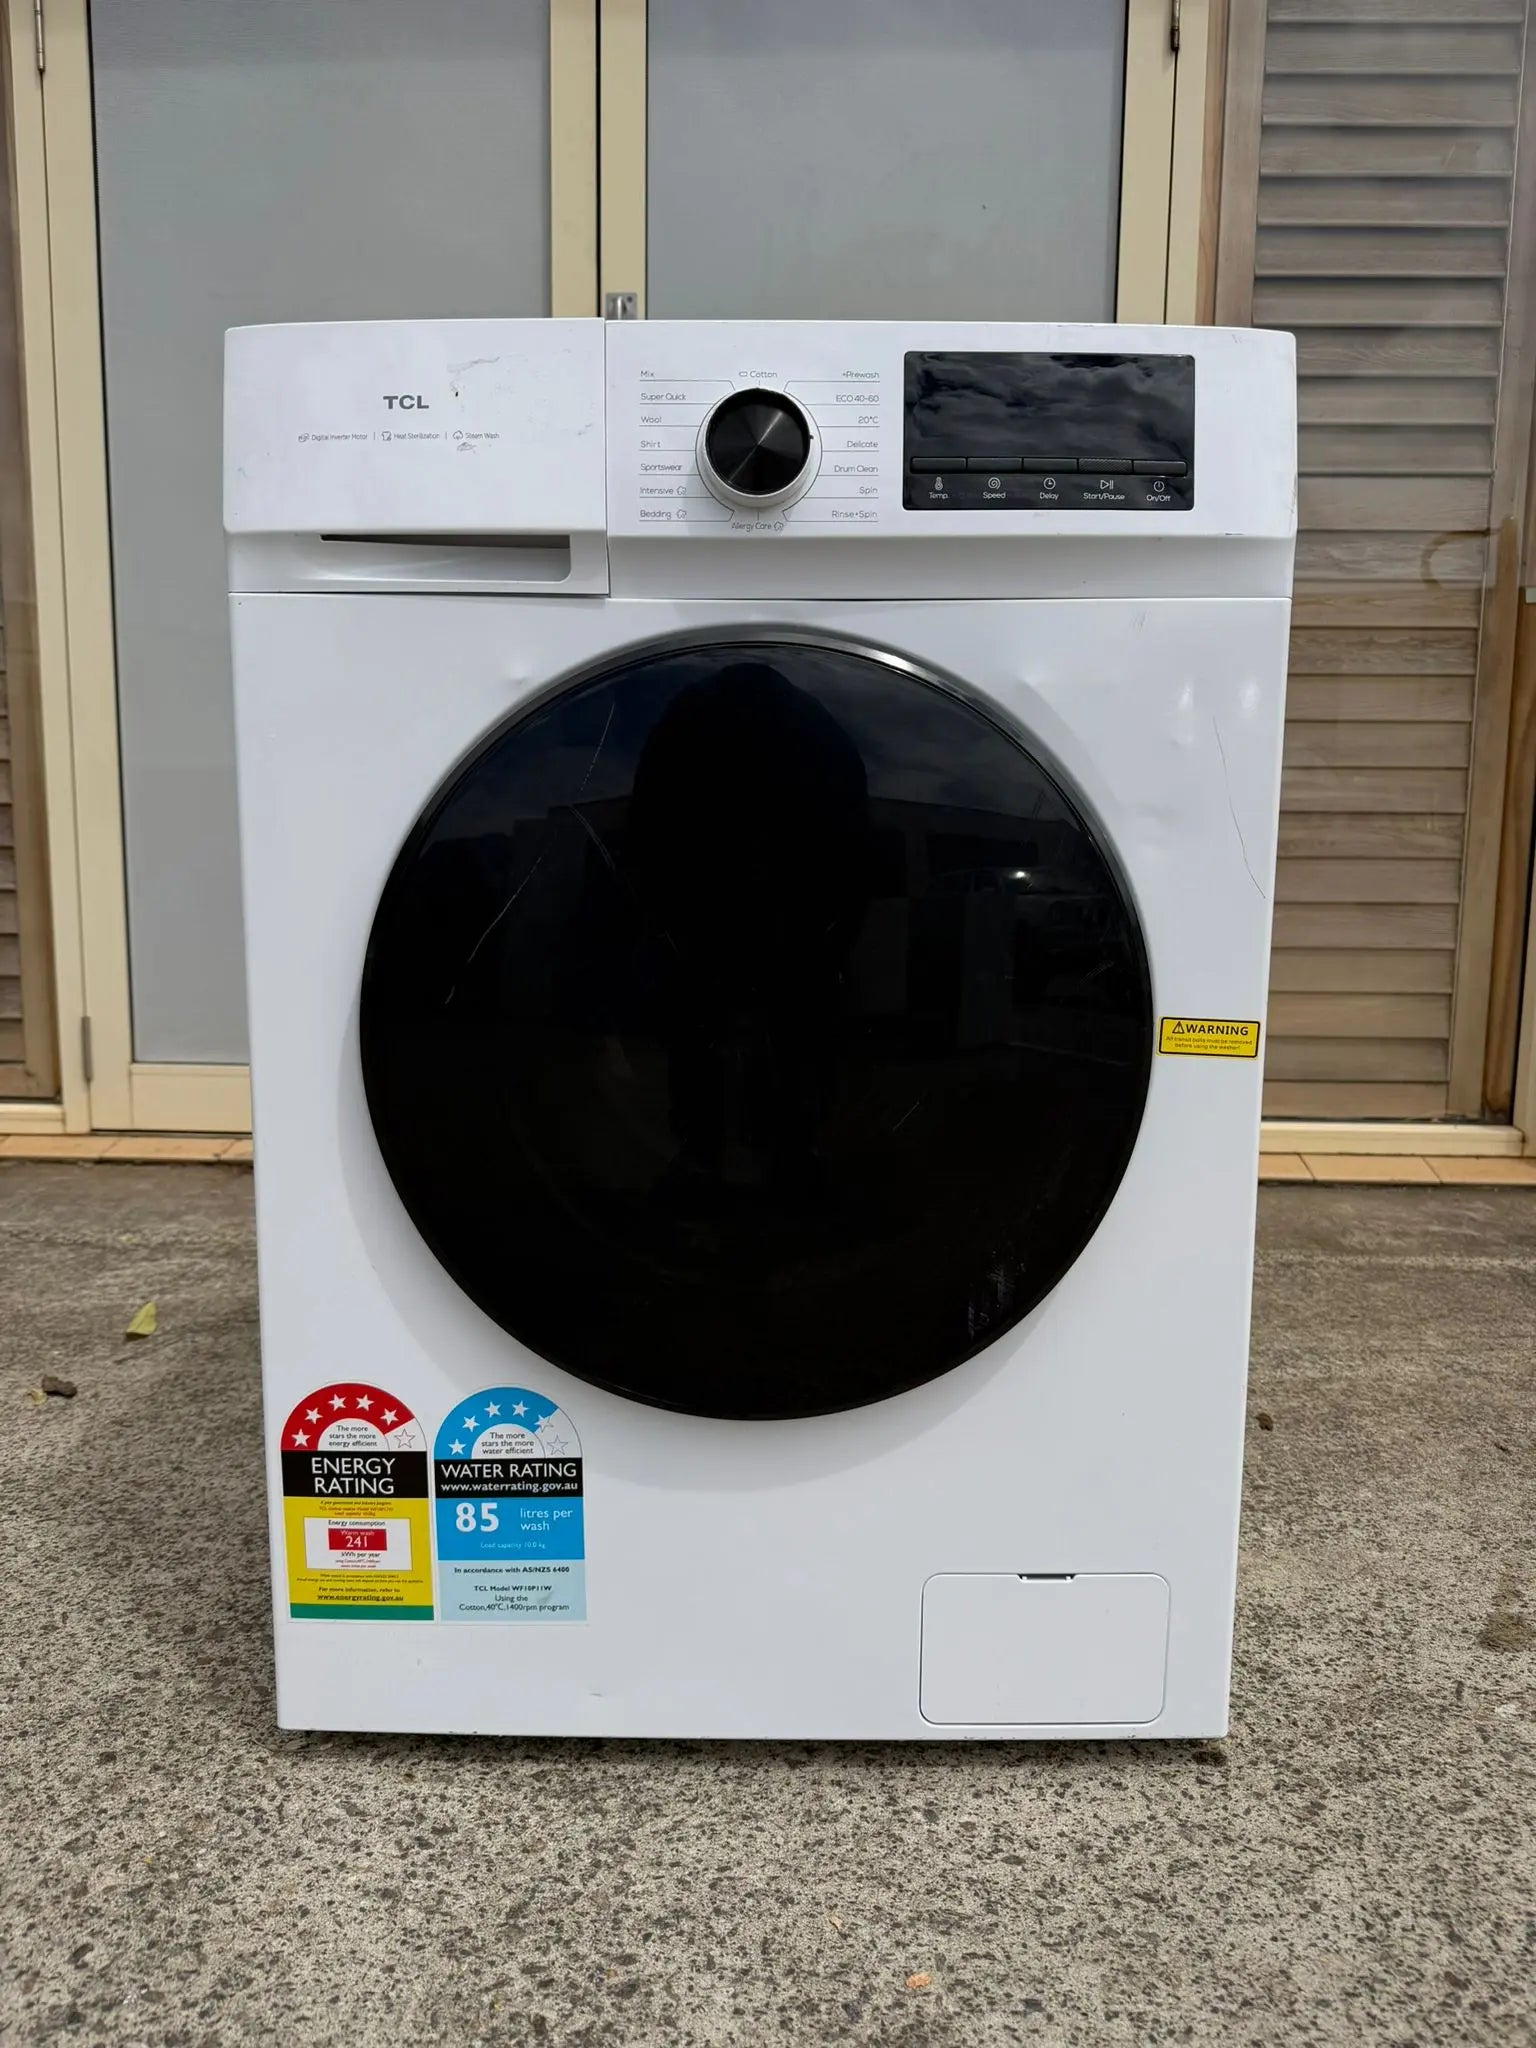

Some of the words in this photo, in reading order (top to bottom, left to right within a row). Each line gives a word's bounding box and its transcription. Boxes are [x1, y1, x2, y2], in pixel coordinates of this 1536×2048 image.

[750, 370, 777, 378] Cotton
[383, 395, 429, 410] TCL
[641, 393, 665, 402] Super
[666, 393, 686, 401] Quick
[858, 416, 879, 424] 20°C
[640, 463, 682, 472] Sportswear
[834, 465, 854, 473] Drum
[855, 465, 878, 473] Clean
[640, 487, 673, 495] Intensive
[859, 487, 878, 495] Spin
[983, 491, 1006, 501] Speed
[1083, 491, 1125, 501] Start/Pause
[1039, 492, 1059, 501] Delay
[1147, 494, 1171, 502] On/Off
[640, 510, 671, 519] Bedding
[732, 522, 754, 532] Allergy
[755, 522, 771, 531] Care
[1186, 1024, 1248, 1035] WARNING
[312, 1458, 395, 1474] ENERGY
[441, 1464, 504, 1478] WATER
[510, 1463, 577, 1478] RATING
[314, 1478, 394, 1494] RATING
[441, 1481, 578, 1493] www.waterrating.gov.au
[456, 1502, 499, 1533] 85
[520, 1508, 549, 1519] litres
[553, 1510, 573, 1520] per
[520, 1521, 550, 1531] wash
[346, 1536, 367, 1548] 241
[495, 1594, 515, 1602] Using
[539, 1604, 570, 1612] program
